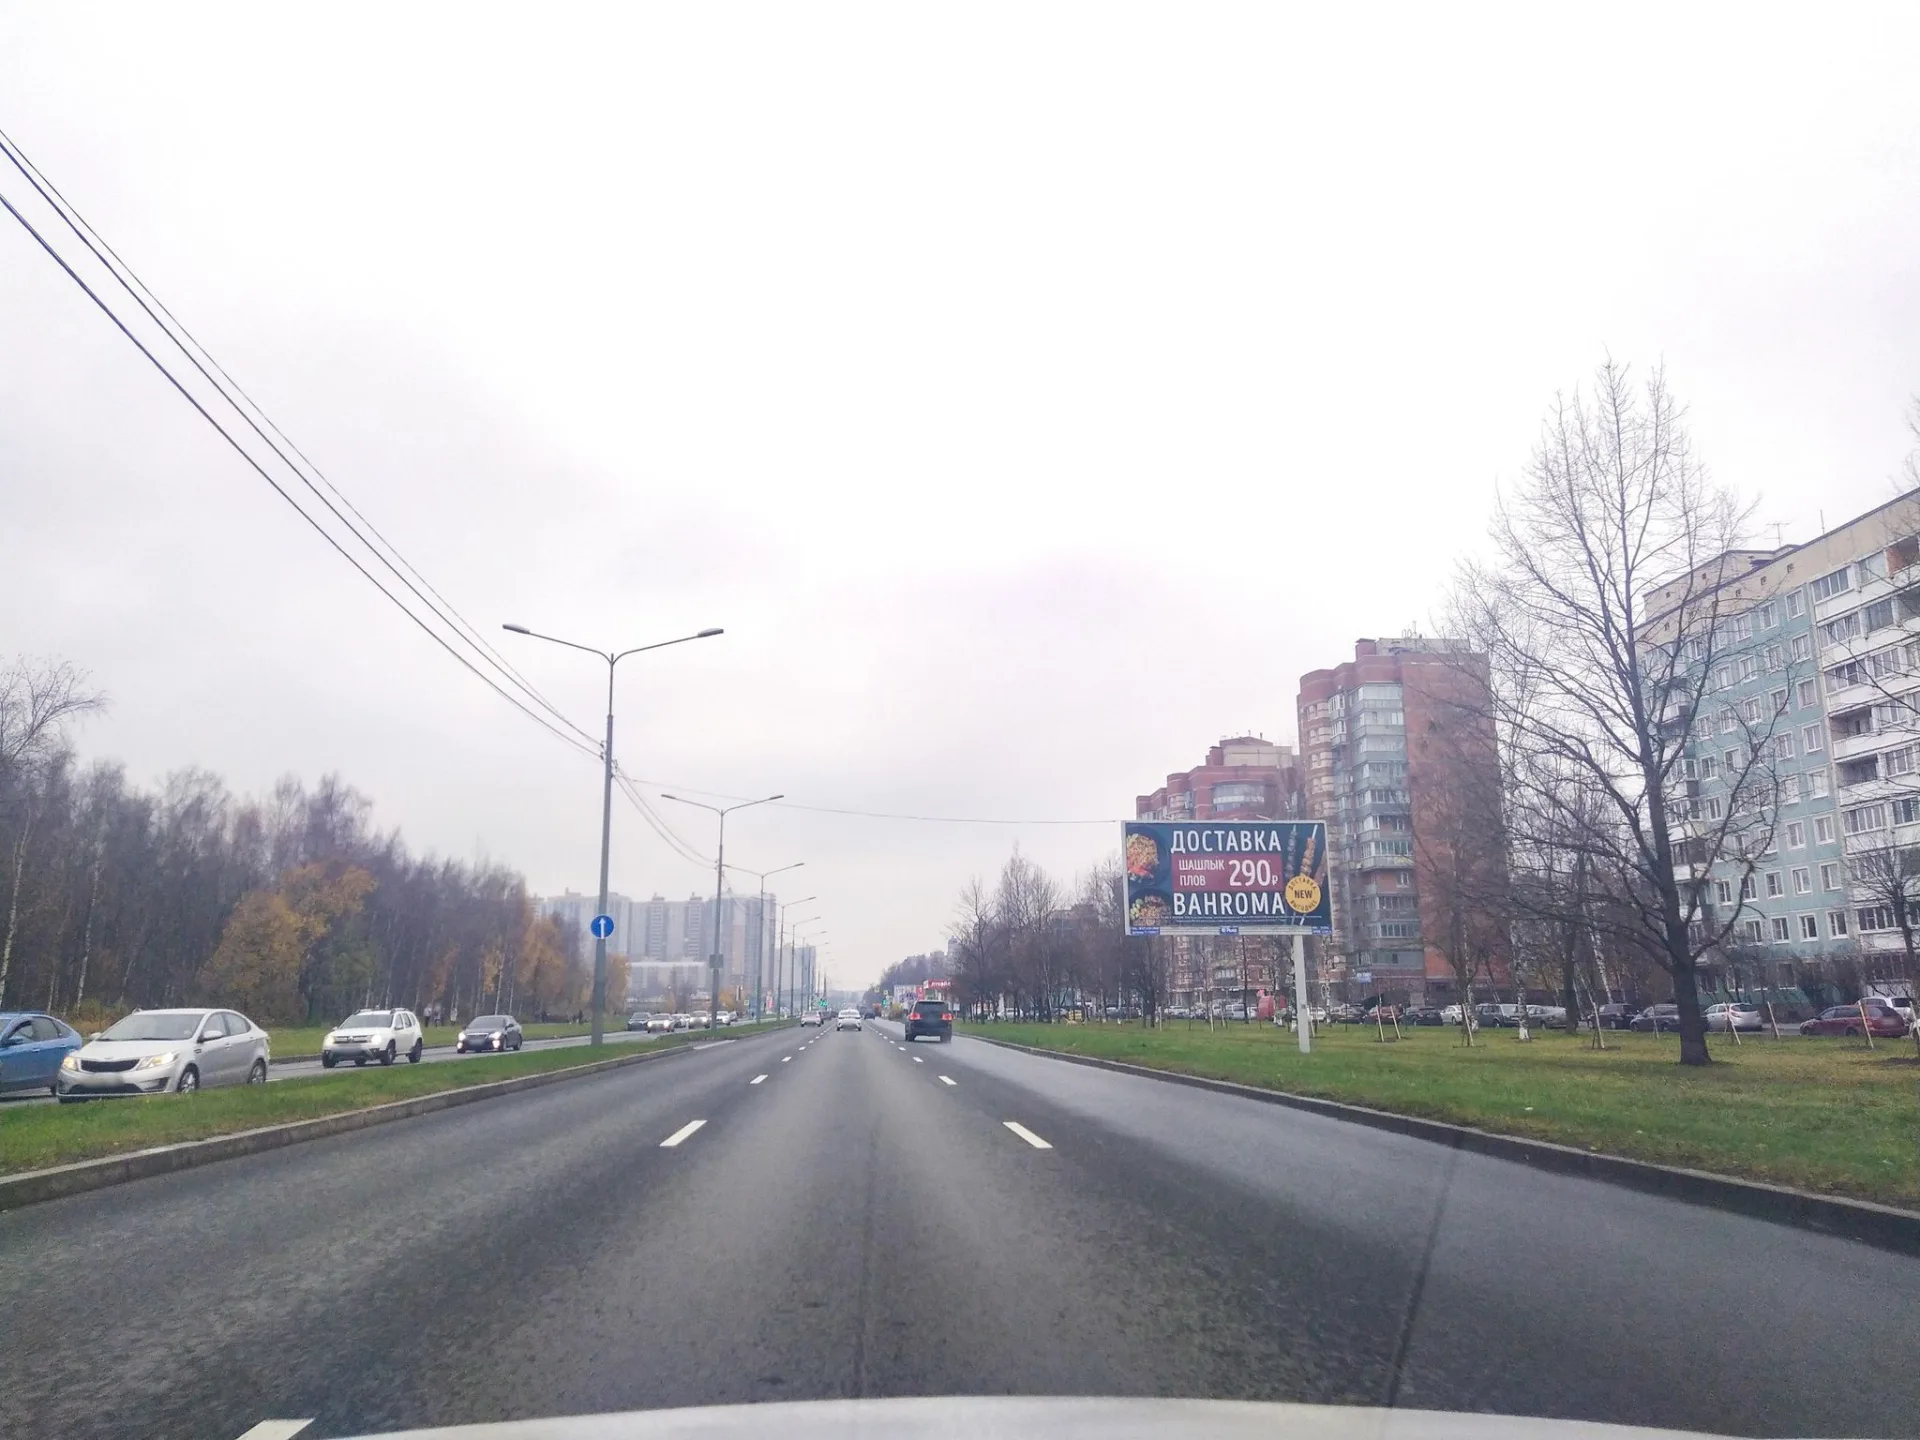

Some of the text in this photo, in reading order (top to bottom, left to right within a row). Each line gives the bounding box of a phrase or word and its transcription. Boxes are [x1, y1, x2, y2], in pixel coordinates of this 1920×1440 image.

[1170, 830, 1282, 854] ДОСТАВКА
[1178, 859, 1225, 871] ШАШЛЫК
[1179, 875, 1206, 886] ПЛОВ
[1294, 889, 1313, 899] NEW
[1173, 892, 1285, 915] BAHROMA
